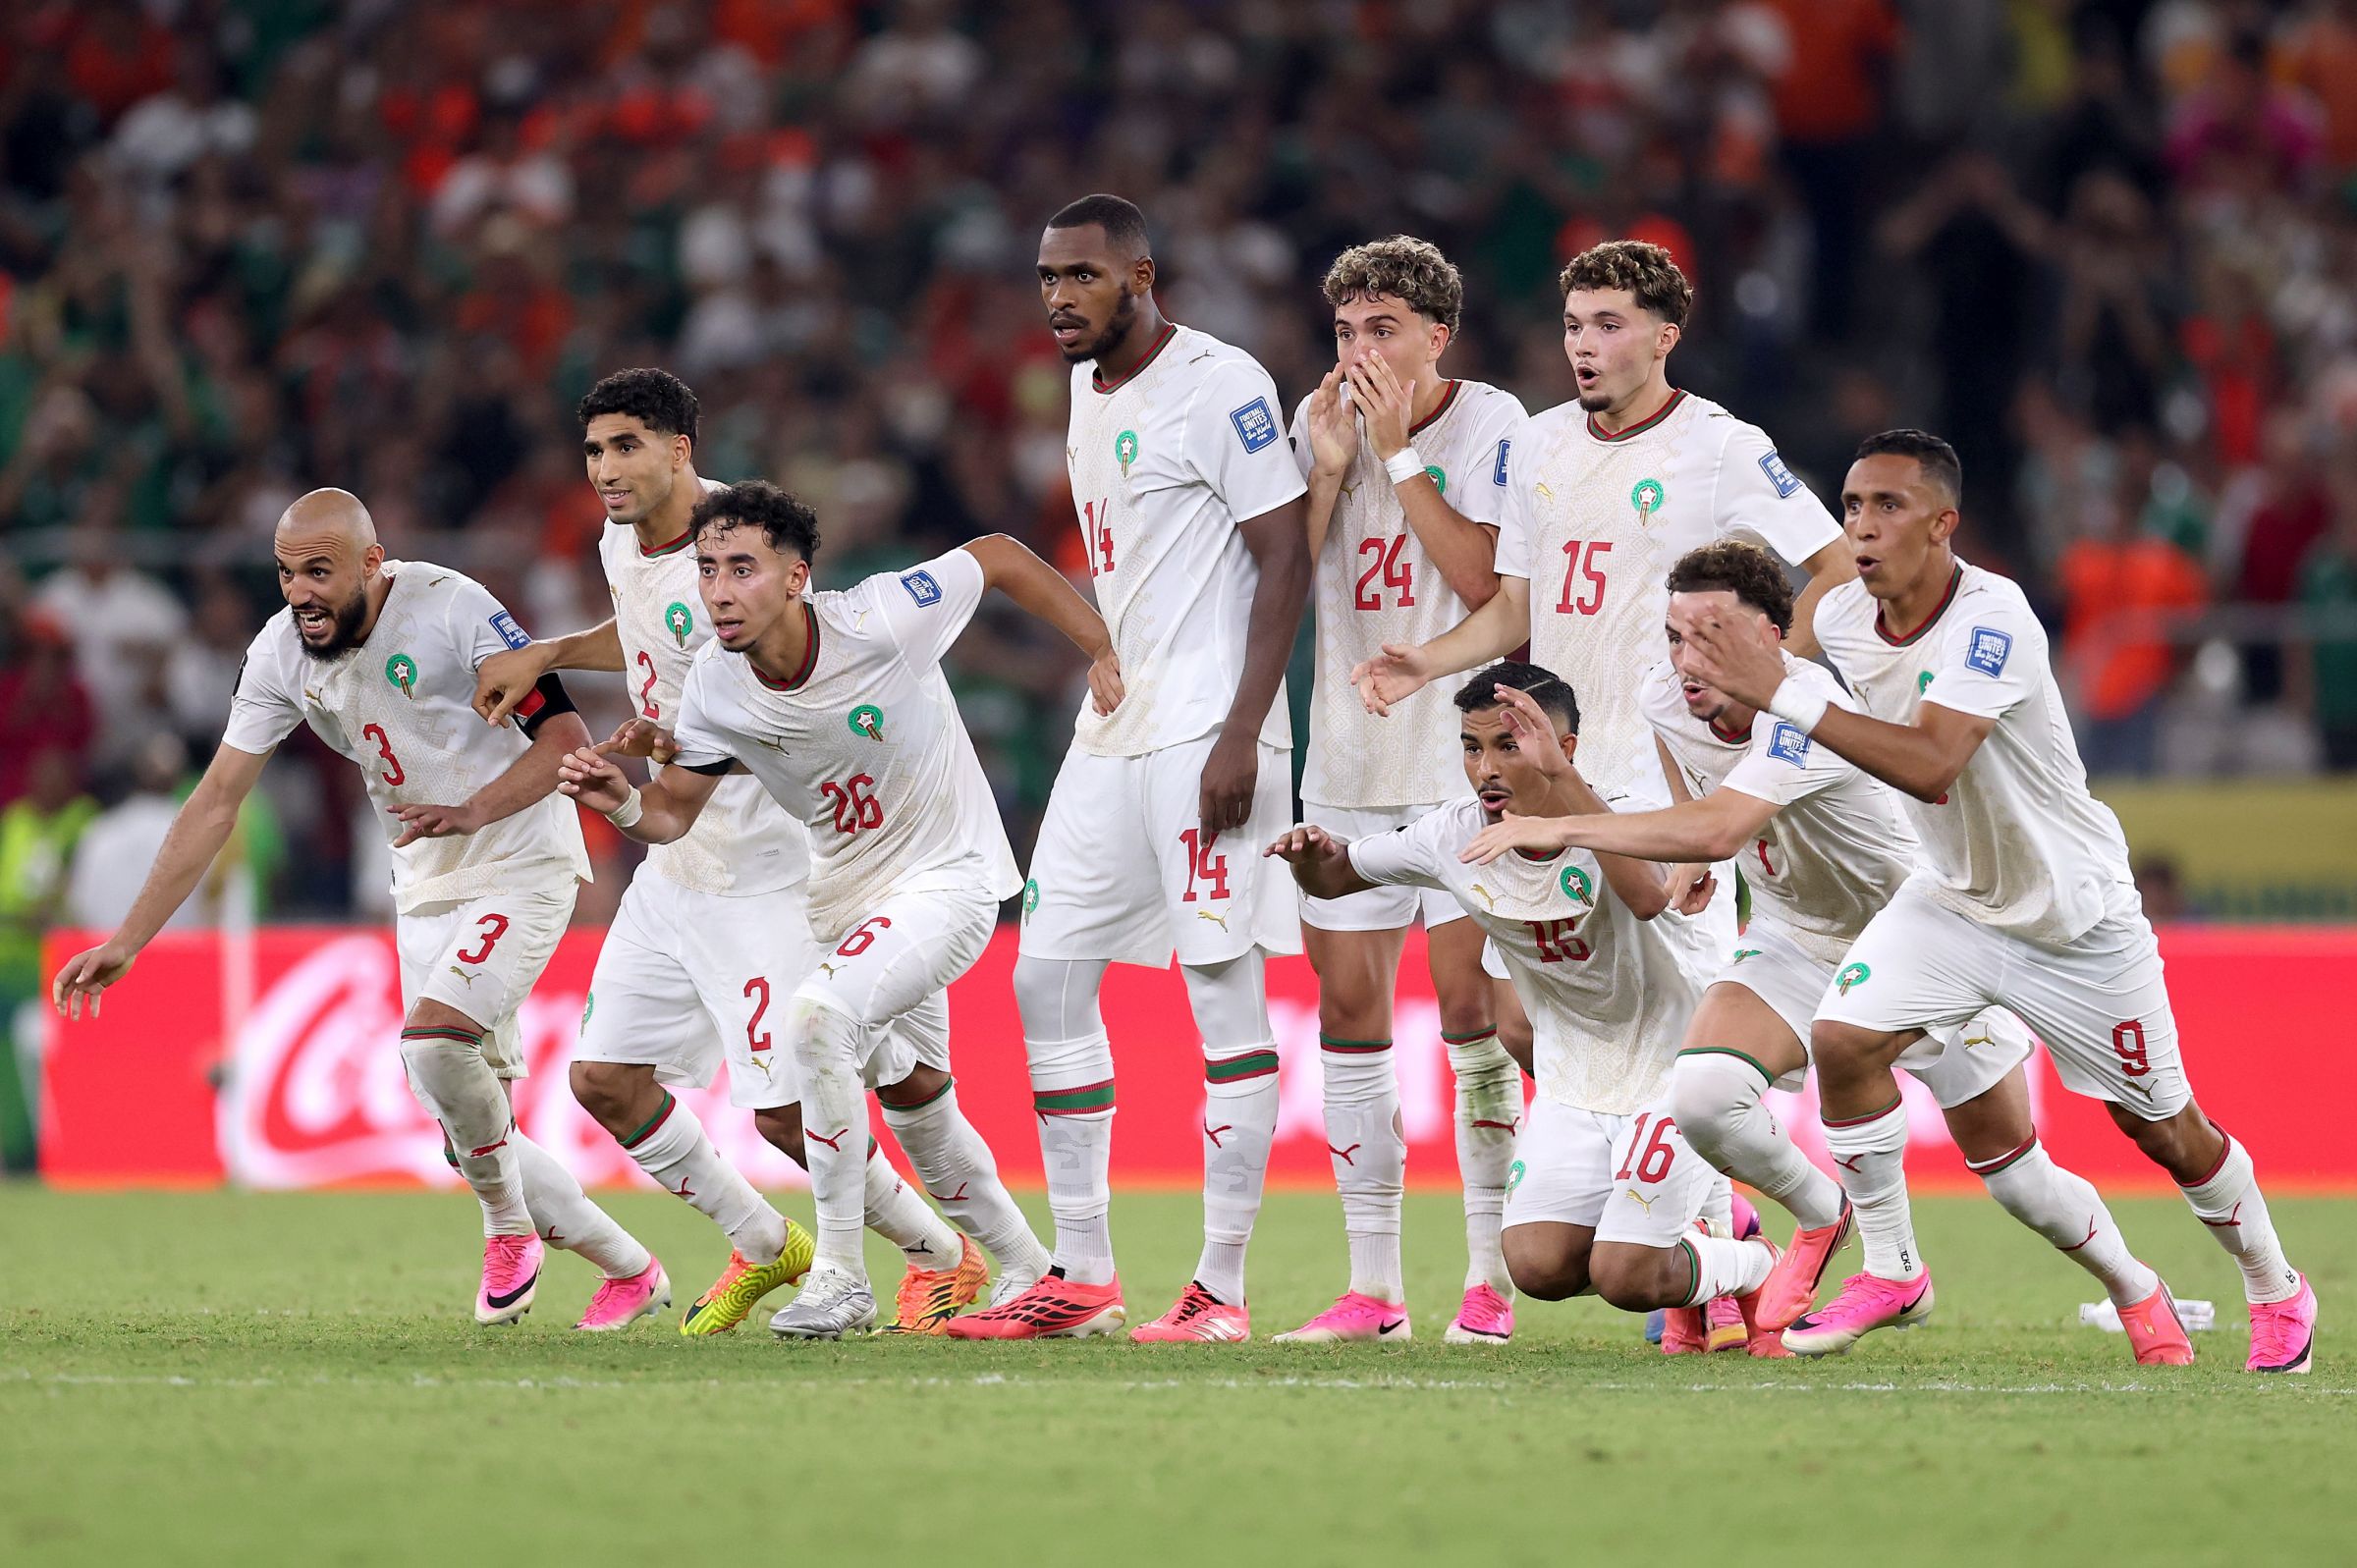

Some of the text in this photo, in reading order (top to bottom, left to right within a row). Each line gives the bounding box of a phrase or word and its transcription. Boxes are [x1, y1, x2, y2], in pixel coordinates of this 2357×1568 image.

[1242, 412, 1268, 432] UNITES
[1083, 497, 1115, 577] 14
[1354, 533, 1415, 611] 24
[1556, 540, 1614, 616] 15
[1977, 641, 2007, 658] UNITES
[638, 650, 661, 720] 2
[362, 723, 406, 786] 3
[1779, 735, 1805, 752] UNITES
[821, 773, 884, 835] 26
[1178, 828, 1231, 902] 14
[457, 913, 509, 964] 3
[1523, 917, 1591, 963] 16
[743, 976, 771, 1053] 2
[2111, 1019, 2149, 1077] 9
[1615, 1111, 1681, 1184] 16
